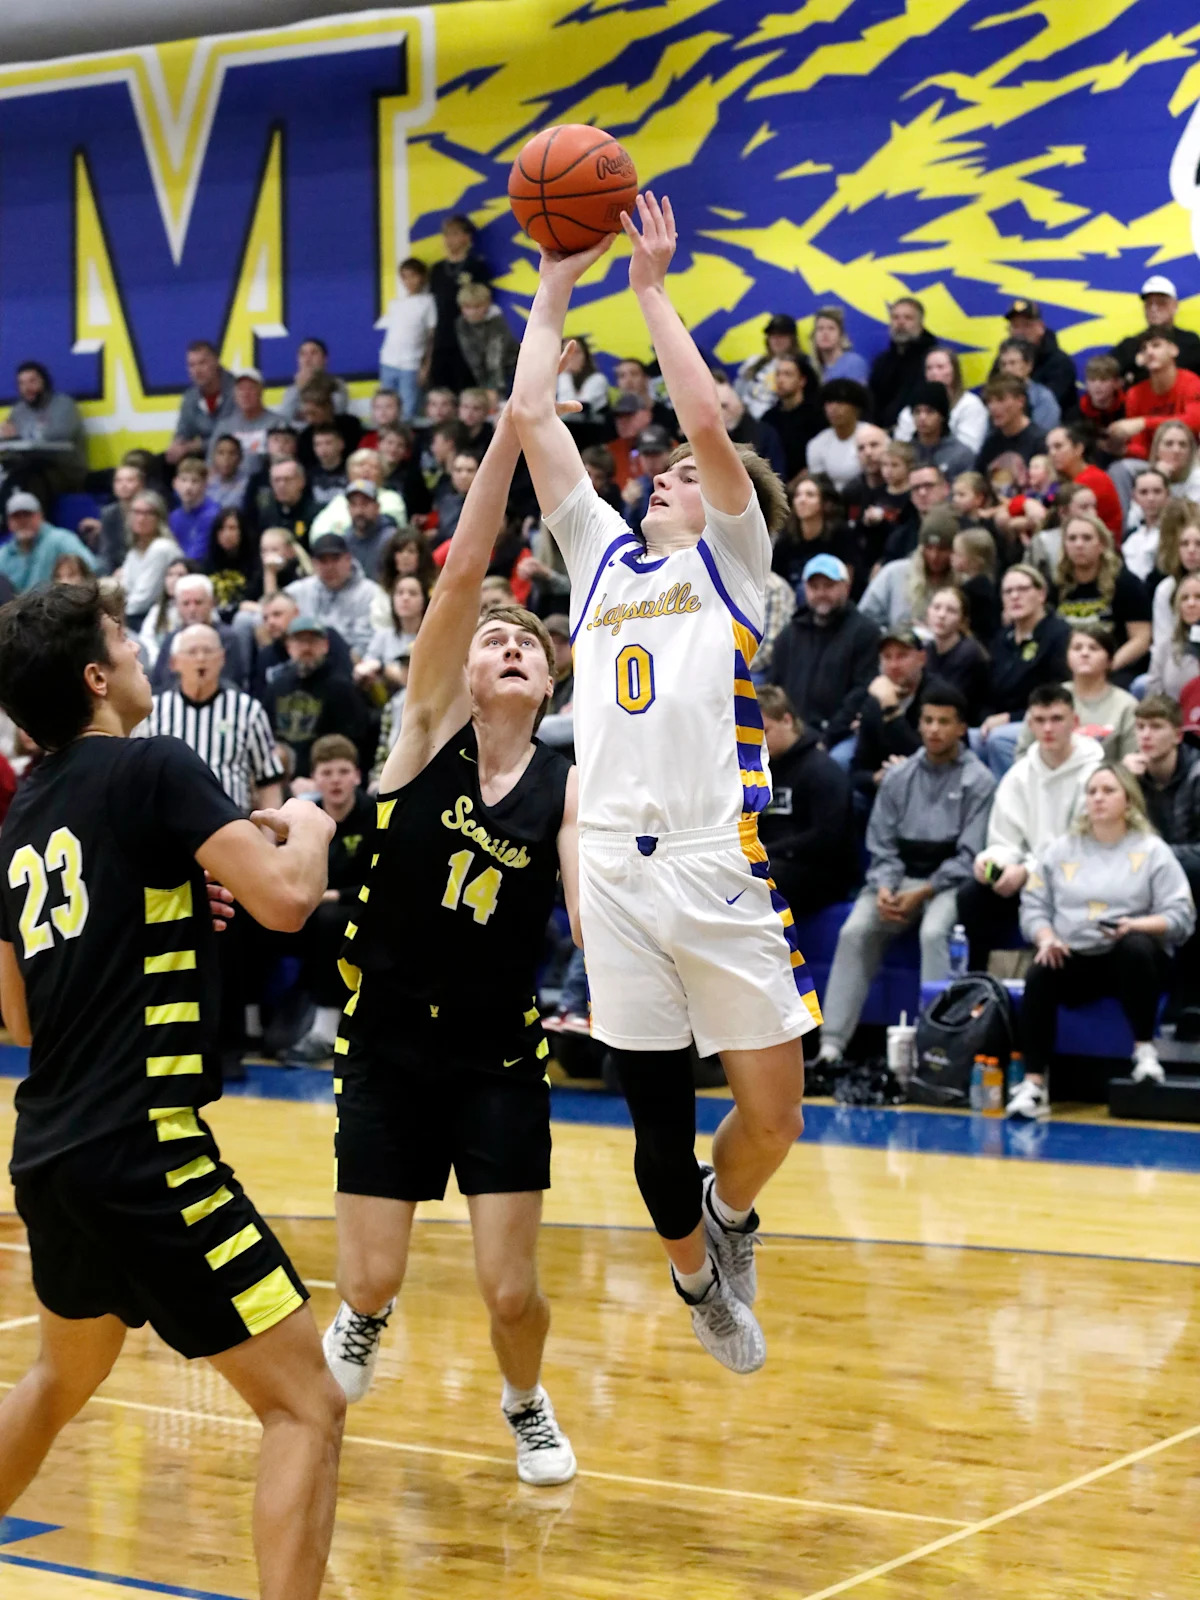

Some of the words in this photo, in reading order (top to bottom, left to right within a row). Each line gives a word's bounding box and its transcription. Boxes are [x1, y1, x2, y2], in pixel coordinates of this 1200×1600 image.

[0, 24, 420, 410] M
[615, 643, 656, 716] 0
[7, 825, 90, 960] 23
[441, 848, 503, 926] 14
